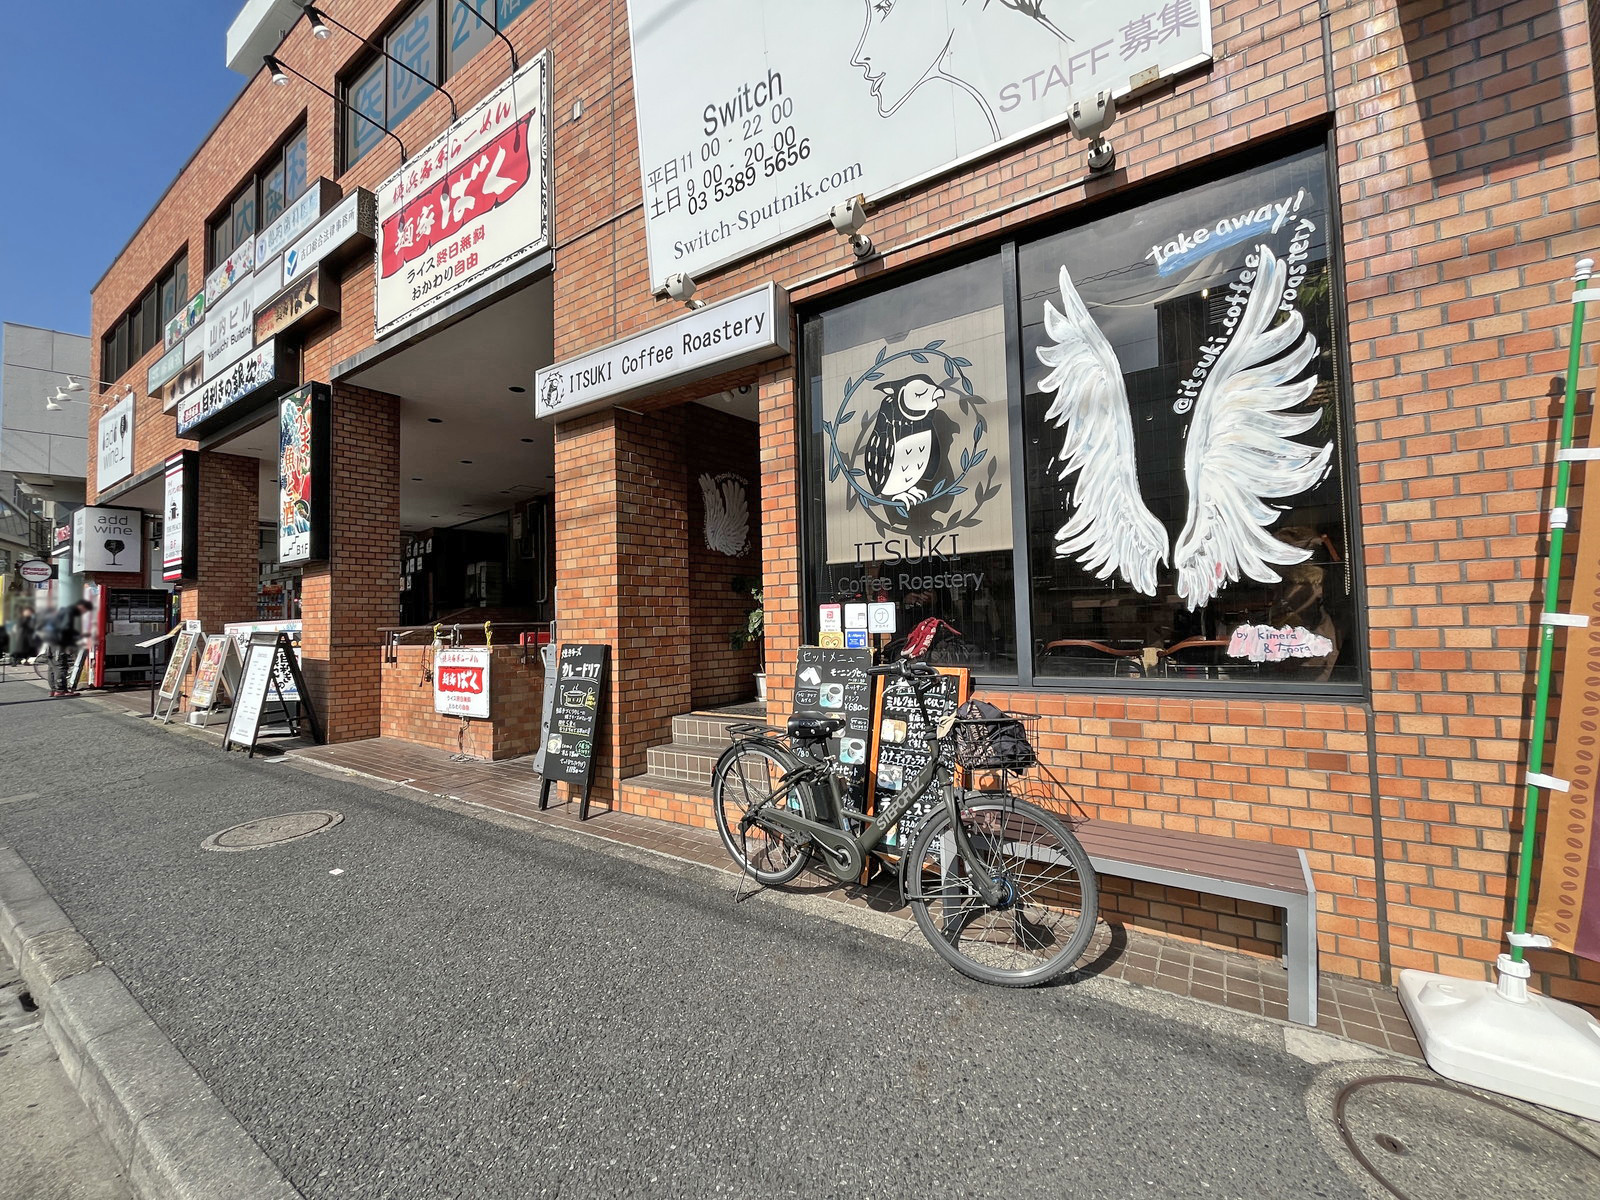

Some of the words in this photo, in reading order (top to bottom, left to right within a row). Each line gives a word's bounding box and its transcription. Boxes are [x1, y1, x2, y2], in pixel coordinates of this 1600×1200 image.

[999, 38, 1114, 112] STAFF
[1118, 0, 1200, 62] 募集
[703, 68, 783, 137] Switch
[743, 114, 763, 141] 22
[771, 97, 793, 125] 00
[650, 186, 681, 220] 土日
[686, 178, 695, 198] 9
[744, 142, 765, 168] 20
[773, 125, 796, 153] 00
[687, 191, 708, 216] 03
[714, 166, 756, 202] 5389
[764, 137, 811, 178] 5656
[393, 145, 518, 256] 麺家ばく
[673, 161, 864, 261] Switch-Sputnik.com
[1145, 228, 1210, 267] take
[1215, 187, 1304, 235] away!
[407, 225, 486, 284] ライス終日無料
[411, 252, 479, 301] おかわり自由
[1279, 218, 1317, 312] roastery
[209, 298, 251, 348] 山内ビル
[569, 361, 612, 393] ITSUKI
[622, 345, 674, 375] Coffee
[683, 312, 766, 356] Roastery
[202, 357, 258, 414] 目利きの銀次
[283, 445, 296, 526] 魚と酒
[93, 525, 133, 536] wine
[98, 515, 128, 526] add
[296, 542, 309, 556] B1F
[853, 533, 961, 569] ITSUKI
[837, 574, 893, 595] Coffee
[898, 570, 985, 592] Roastery
[803, 650, 865, 663] セットメニュー
[1236, 629, 1249, 641] by
[1257, 628, 1298, 640] kimera
[1263, 642, 1274, 654] &
[562, 662, 601, 678] カレードリア
[876, 776, 925, 831] STEPCRUZ
